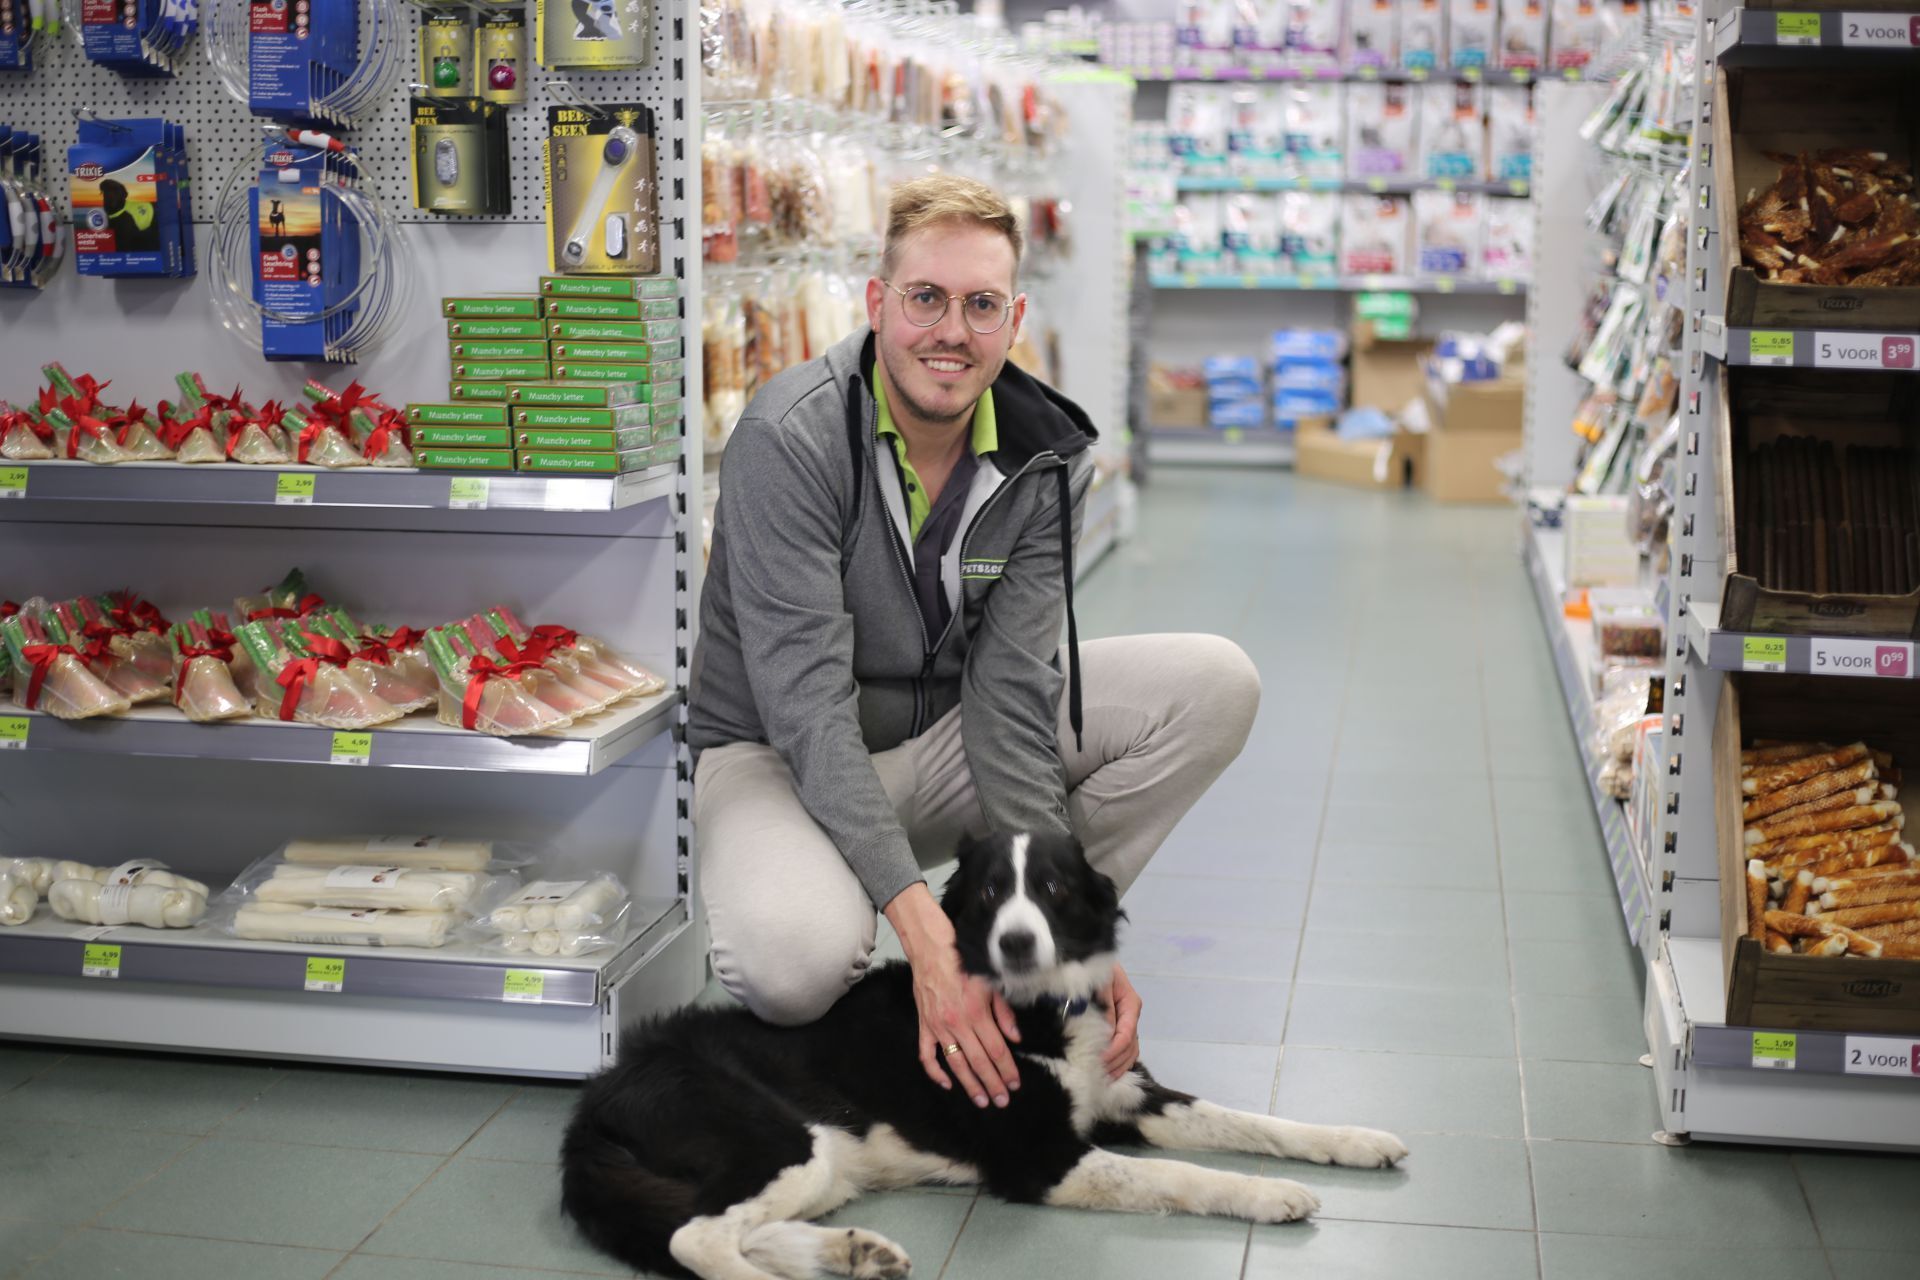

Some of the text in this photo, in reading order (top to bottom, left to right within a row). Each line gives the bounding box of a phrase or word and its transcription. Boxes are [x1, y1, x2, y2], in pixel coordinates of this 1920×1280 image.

[1848, 24, 1859, 38] 2
[1865, 28, 1906, 39] VOOR
[417, 107, 436, 116] BEE
[557, 110, 585, 123] BEE
[414, 117, 438, 126] SEEN
[553, 124, 589, 137] SEEN
[269, 154, 294, 163] TRIXIE
[74, 165, 104, 178] TRIXIE
[263, 260, 294, 269] Leuchtring
[559, 283, 591, 295] Munchy
[463, 304, 495, 315] Munchy
[565, 304, 598, 316] Munchy
[468, 325, 501, 336] Munchy
[471, 347, 503, 357] Munchy
[1821, 343, 1832, 359] 5
[1838, 347, 1878, 360] VOOR
[472, 367, 505, 379] Munchy
[573, 368, 606, 379] Munchy
[470, 387, 502, 398] Munchy
[528, 391, 562, 403] Munchy
[428, 411, 462, 422] Munchy
[535, 414, 569, 426] Munchy
[432, 432, 465, 443] Munchy
[536, 436, 570, 447] Munchy
[435, 455, 468, 466] Munchy
[539, 457, 574, 469] Munchy
[1816, 651, 1827, 666] 5
[1832, 655, 1873, 668] VOOR
[1851, 1049, 1908, 1068] 2 VOOR
